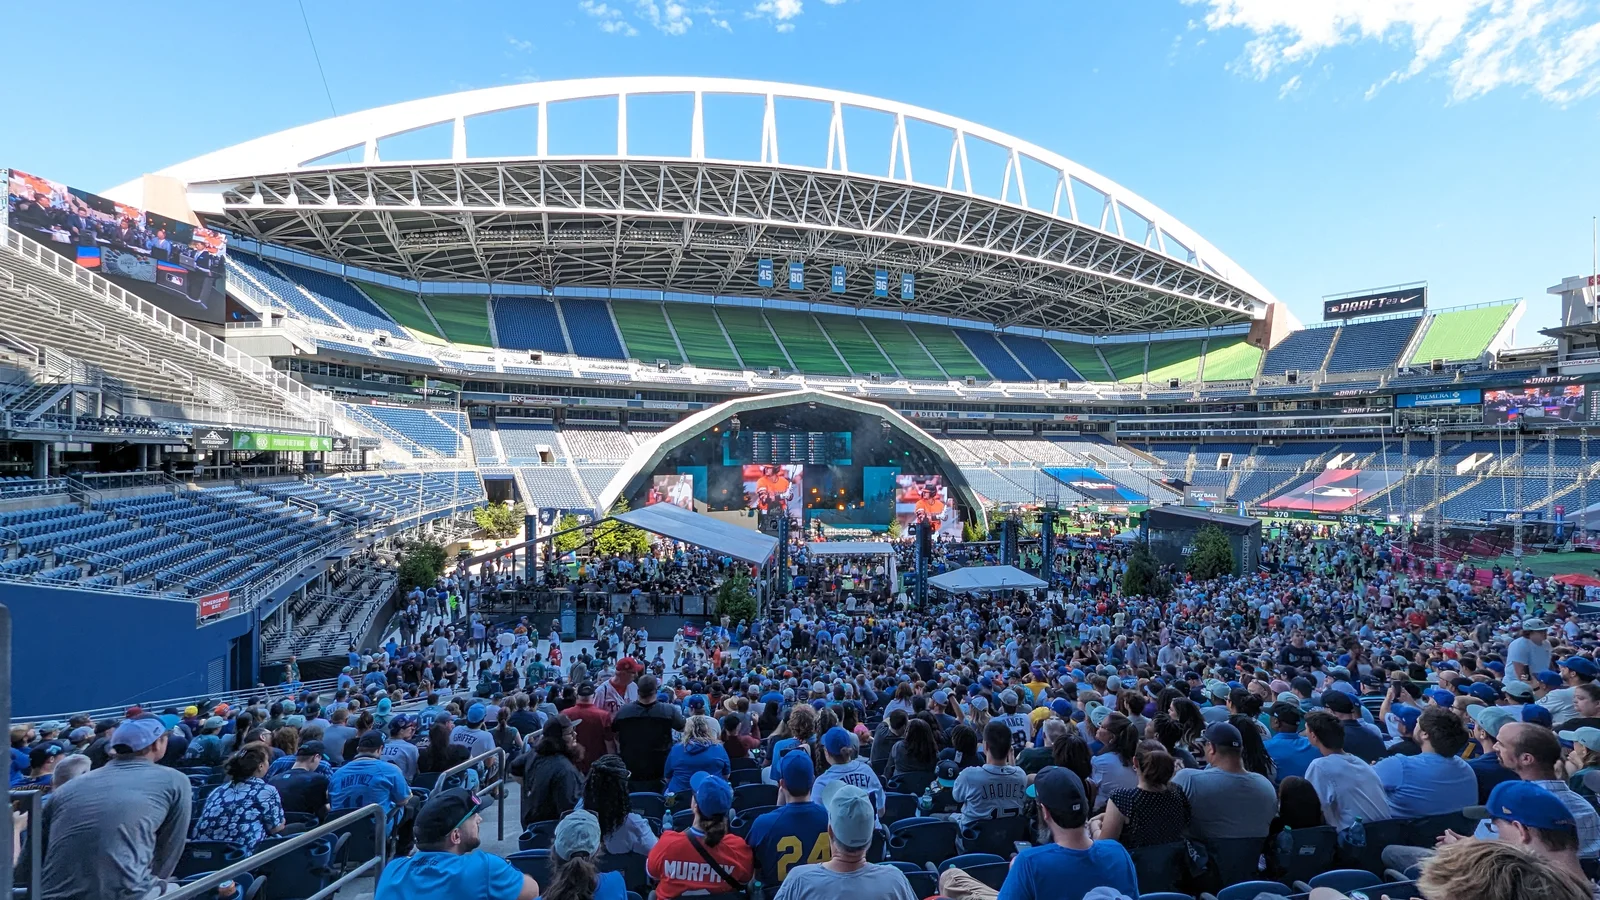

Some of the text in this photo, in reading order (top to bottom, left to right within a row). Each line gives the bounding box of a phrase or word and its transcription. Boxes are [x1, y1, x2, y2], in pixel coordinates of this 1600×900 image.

[760, 269, 772, 281] 45
[791, 272, 803, 283] 80
[834, 276, 844, 286] 12
[876, 281, 887, 291] 96
[903, 284, 913, 293] 71
[1339, 297, 1387, 313] DRAFT
[203, 596, 229, 606] EMERGENCY
[454, 733, 477, 745] GRIFFEY
[341, 773, 373, 789] MARTINEZ
[776, 831, 832, 881] 24
